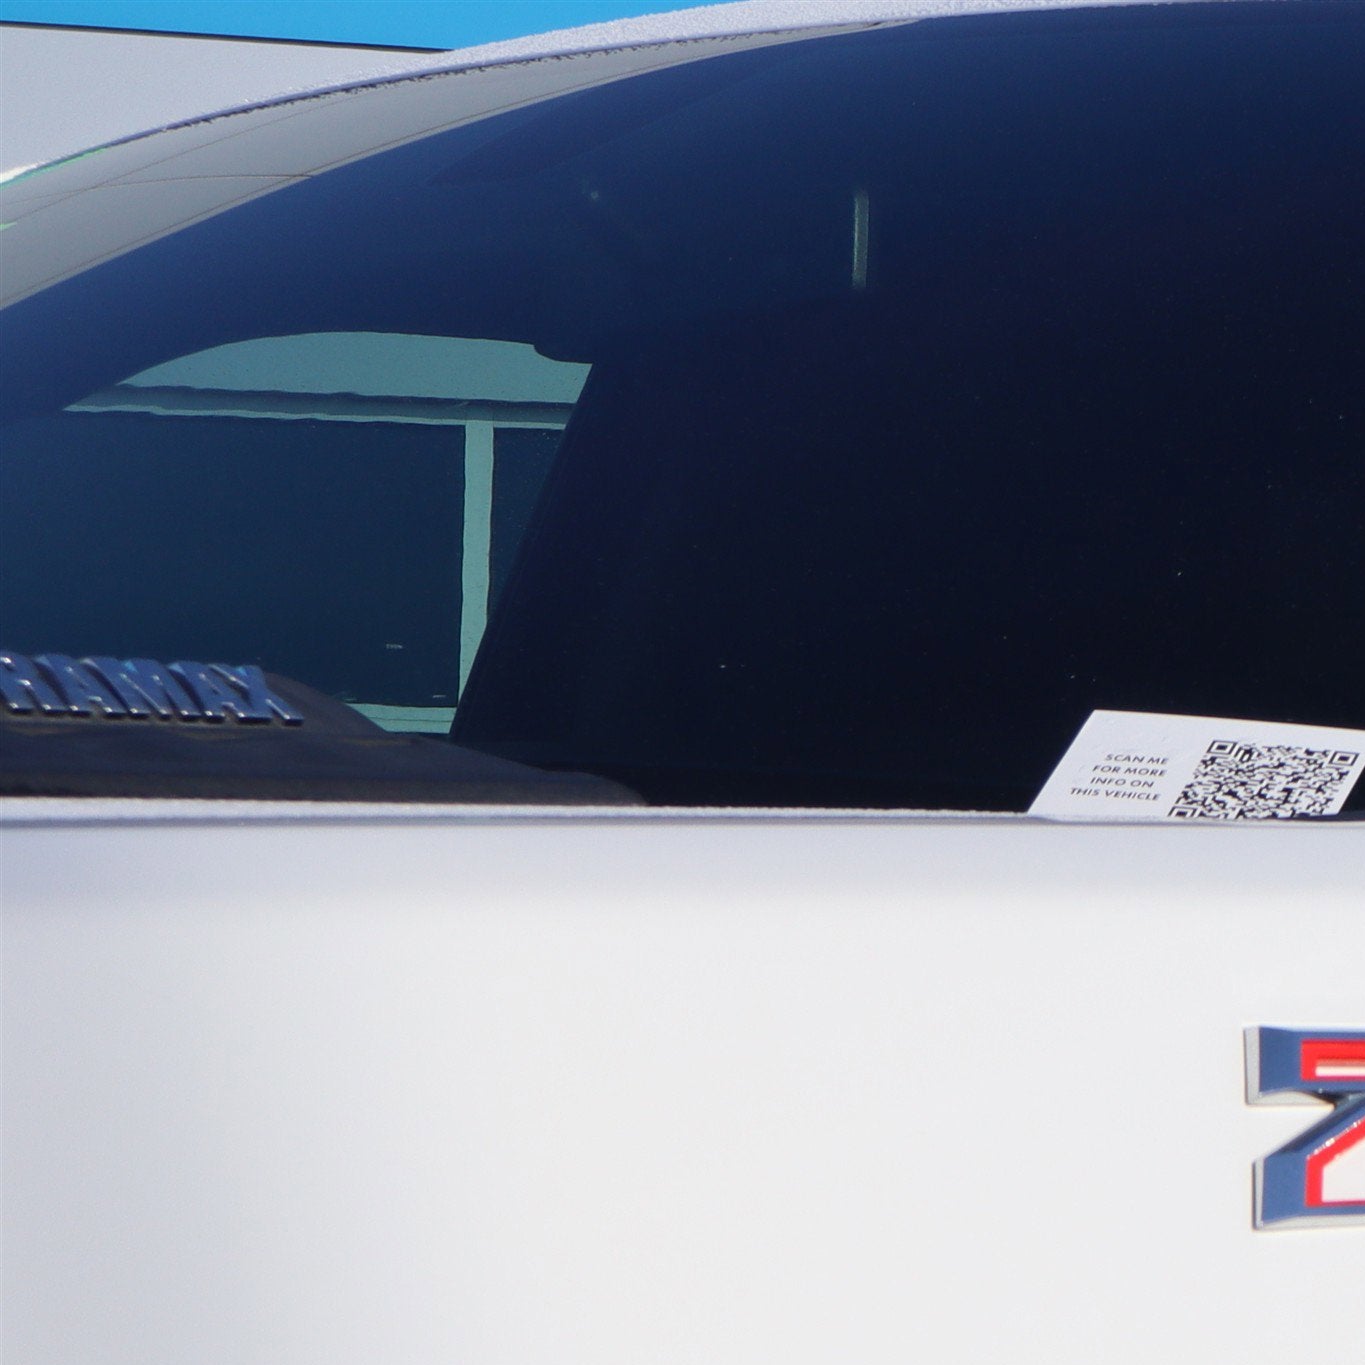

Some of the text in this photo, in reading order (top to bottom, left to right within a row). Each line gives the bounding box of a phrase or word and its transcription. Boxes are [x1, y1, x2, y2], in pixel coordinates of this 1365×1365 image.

[1105, 753, 1169, 765] SCAN ME
[1092, 765, 1167, 776] FOR MORE
[1090, 777, 1155, 788] INFO ON
[1070, 787, 1161, 801] THIS VEHICLE
